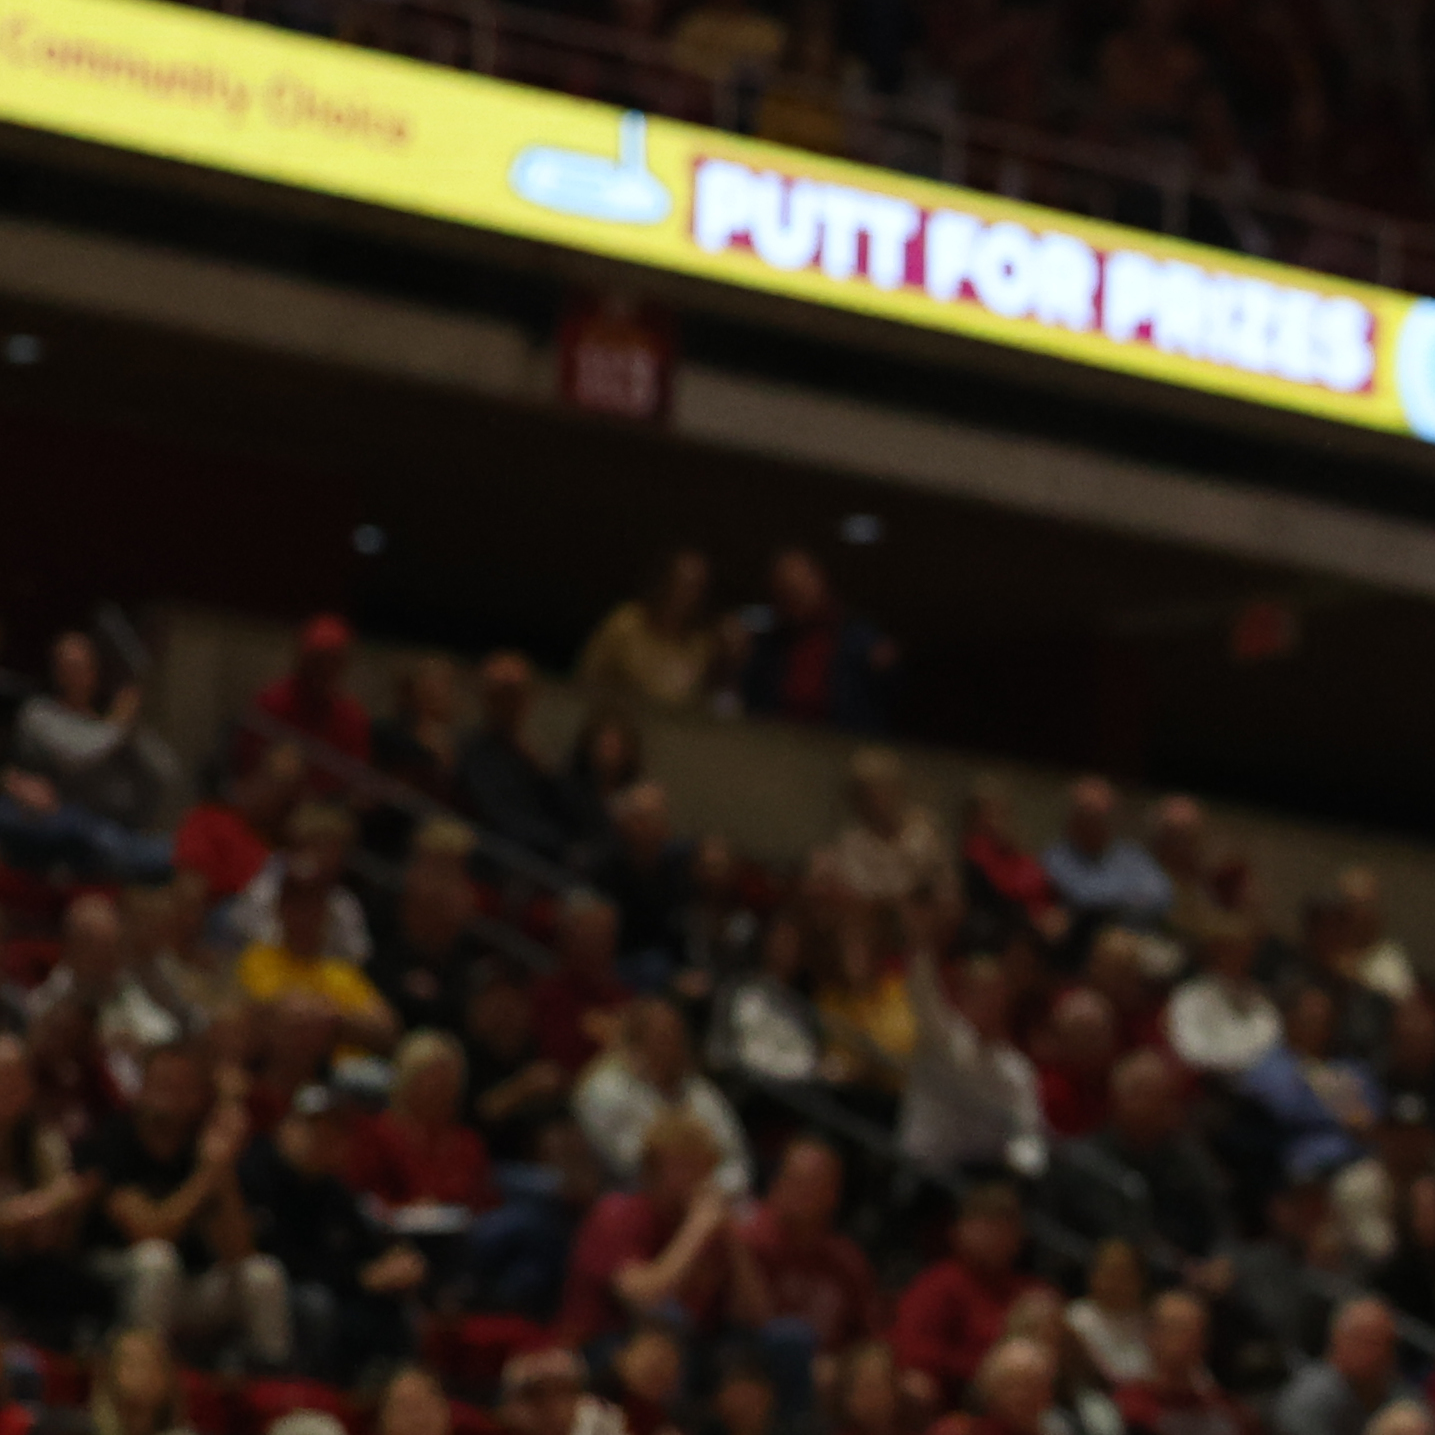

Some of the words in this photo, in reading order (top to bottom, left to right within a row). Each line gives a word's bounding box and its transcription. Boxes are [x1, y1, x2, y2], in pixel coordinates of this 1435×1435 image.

[696, 159, 917, 288] PUTT
[926, 210, 1097, 330] FOR
[1105, 251, 1373, 391] PRIZES
